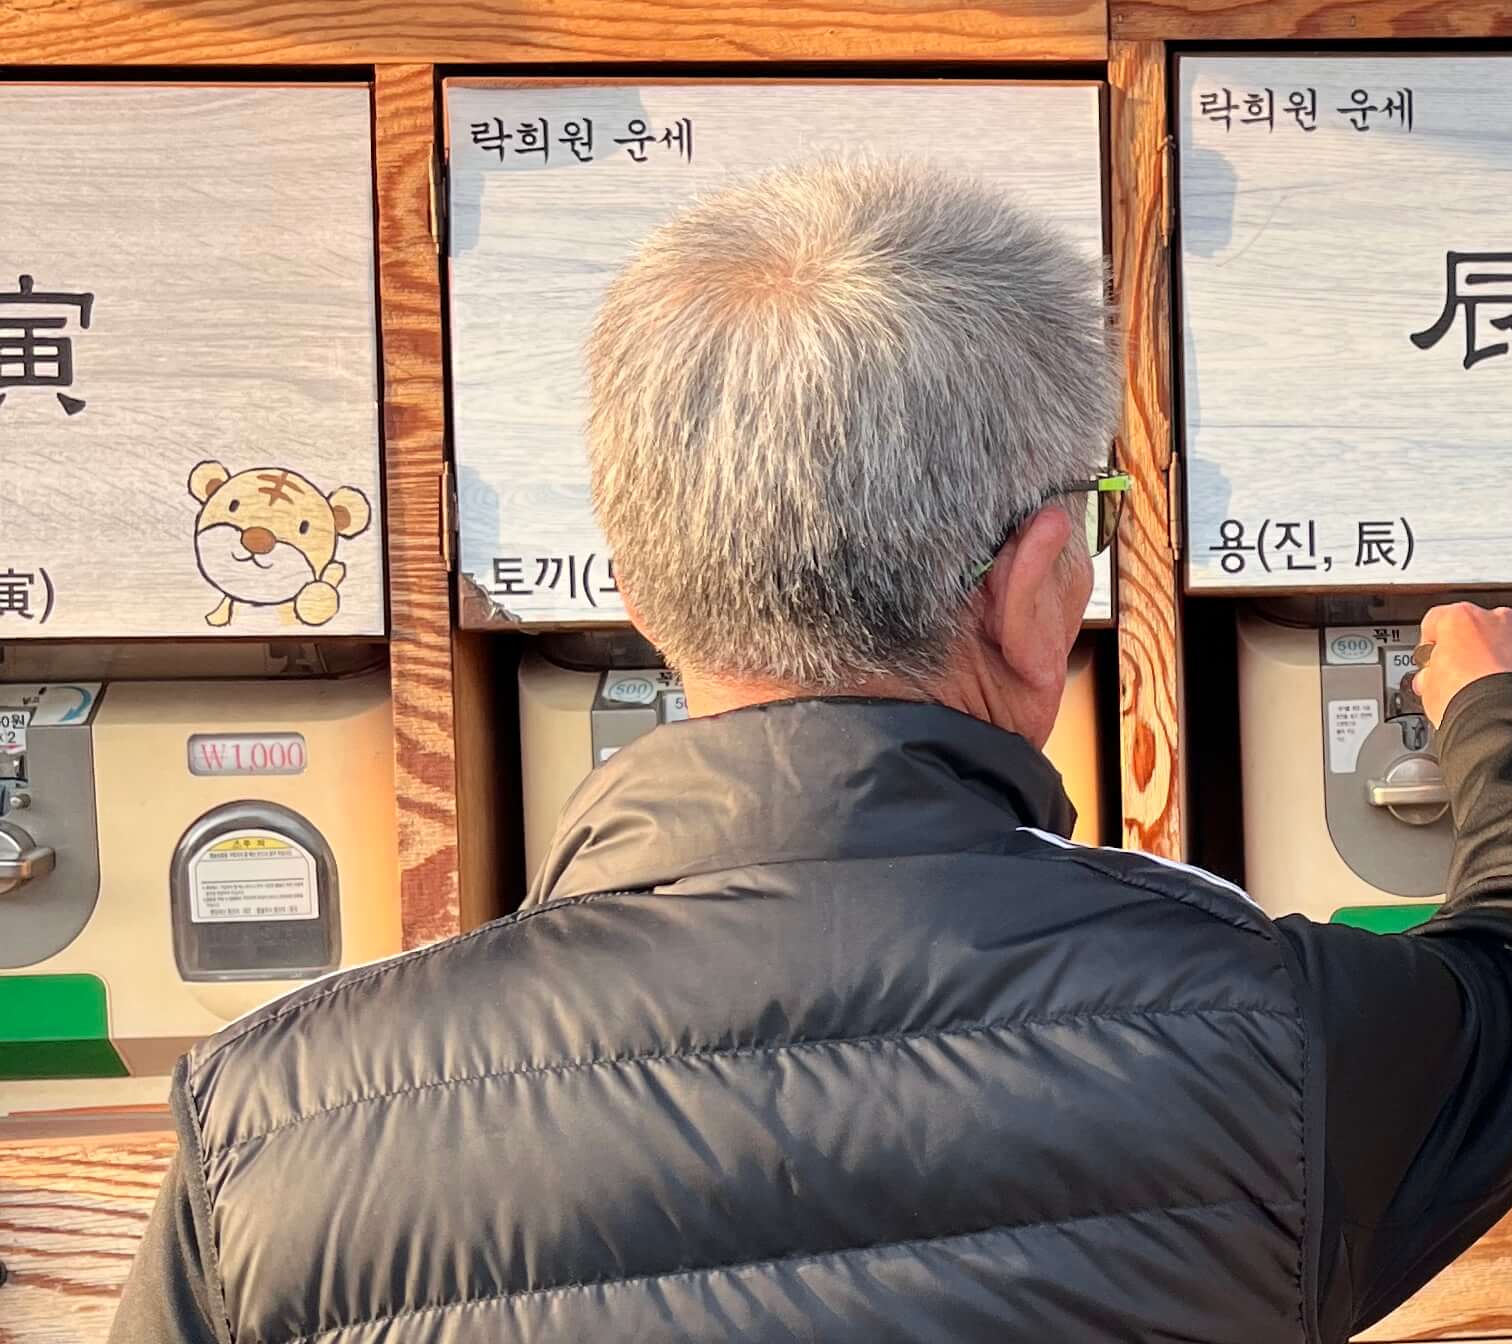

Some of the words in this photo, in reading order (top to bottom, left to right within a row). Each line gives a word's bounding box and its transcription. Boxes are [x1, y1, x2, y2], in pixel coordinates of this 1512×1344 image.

[1200, 88, 1318, 133] 락희원
[1337, 88, 1414, 133] 운세
[470, 117, 593, 163] 락희원
[613, 117, 692, 164] 운세
[1209, 518, 1333, 573] 용(진,
[1355, 517, 1415, 572] 辰)
